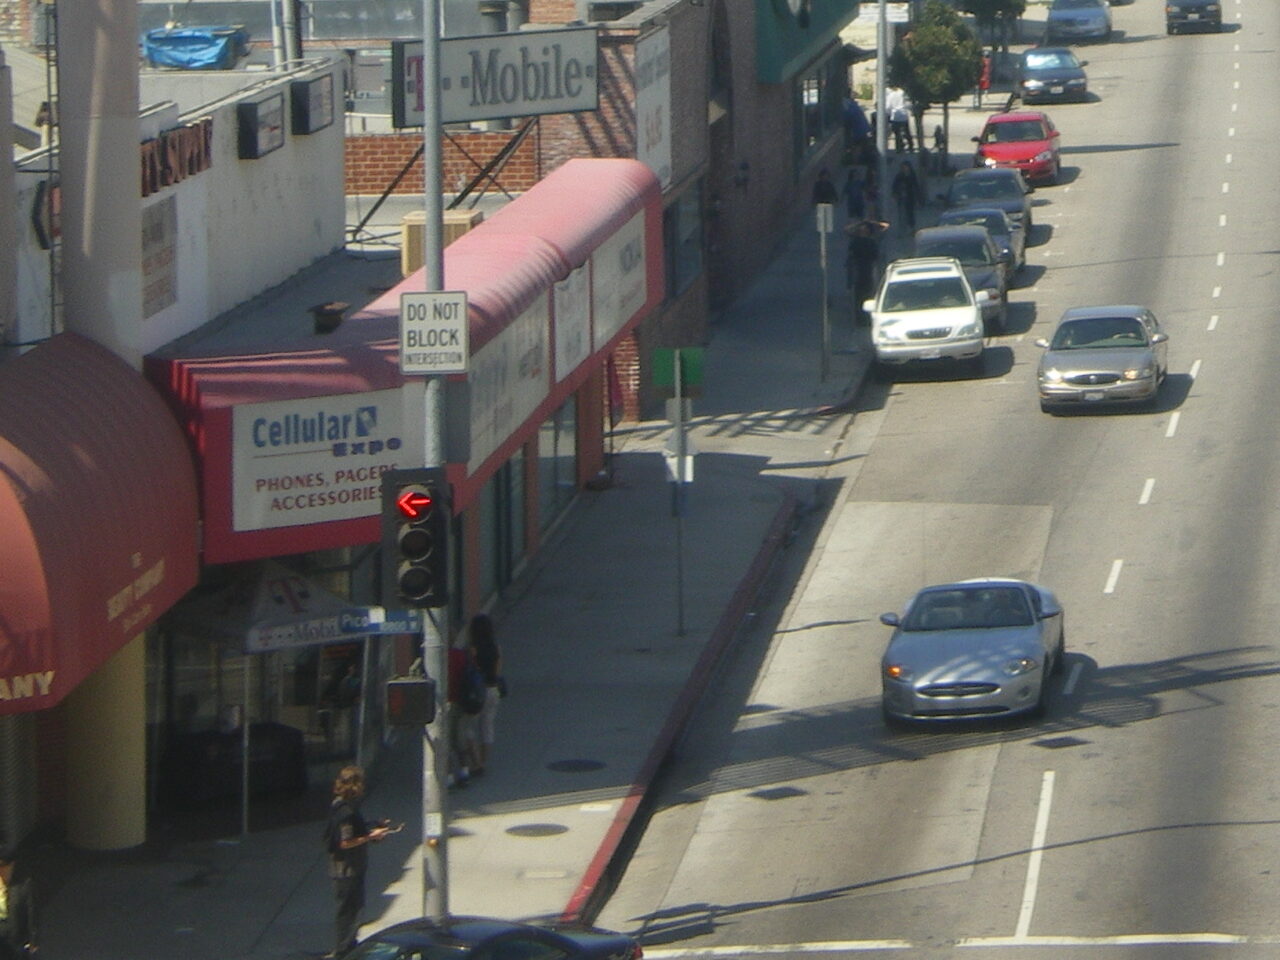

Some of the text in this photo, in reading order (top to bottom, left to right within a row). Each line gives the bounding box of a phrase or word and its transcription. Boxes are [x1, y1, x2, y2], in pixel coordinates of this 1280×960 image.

[468, 43, 583, 107] Mobile
[407, 302, 460, 321] DO NOT
[407, 328, 460, 348] BLOCK
[253, 411, 352, 448] Cellular
